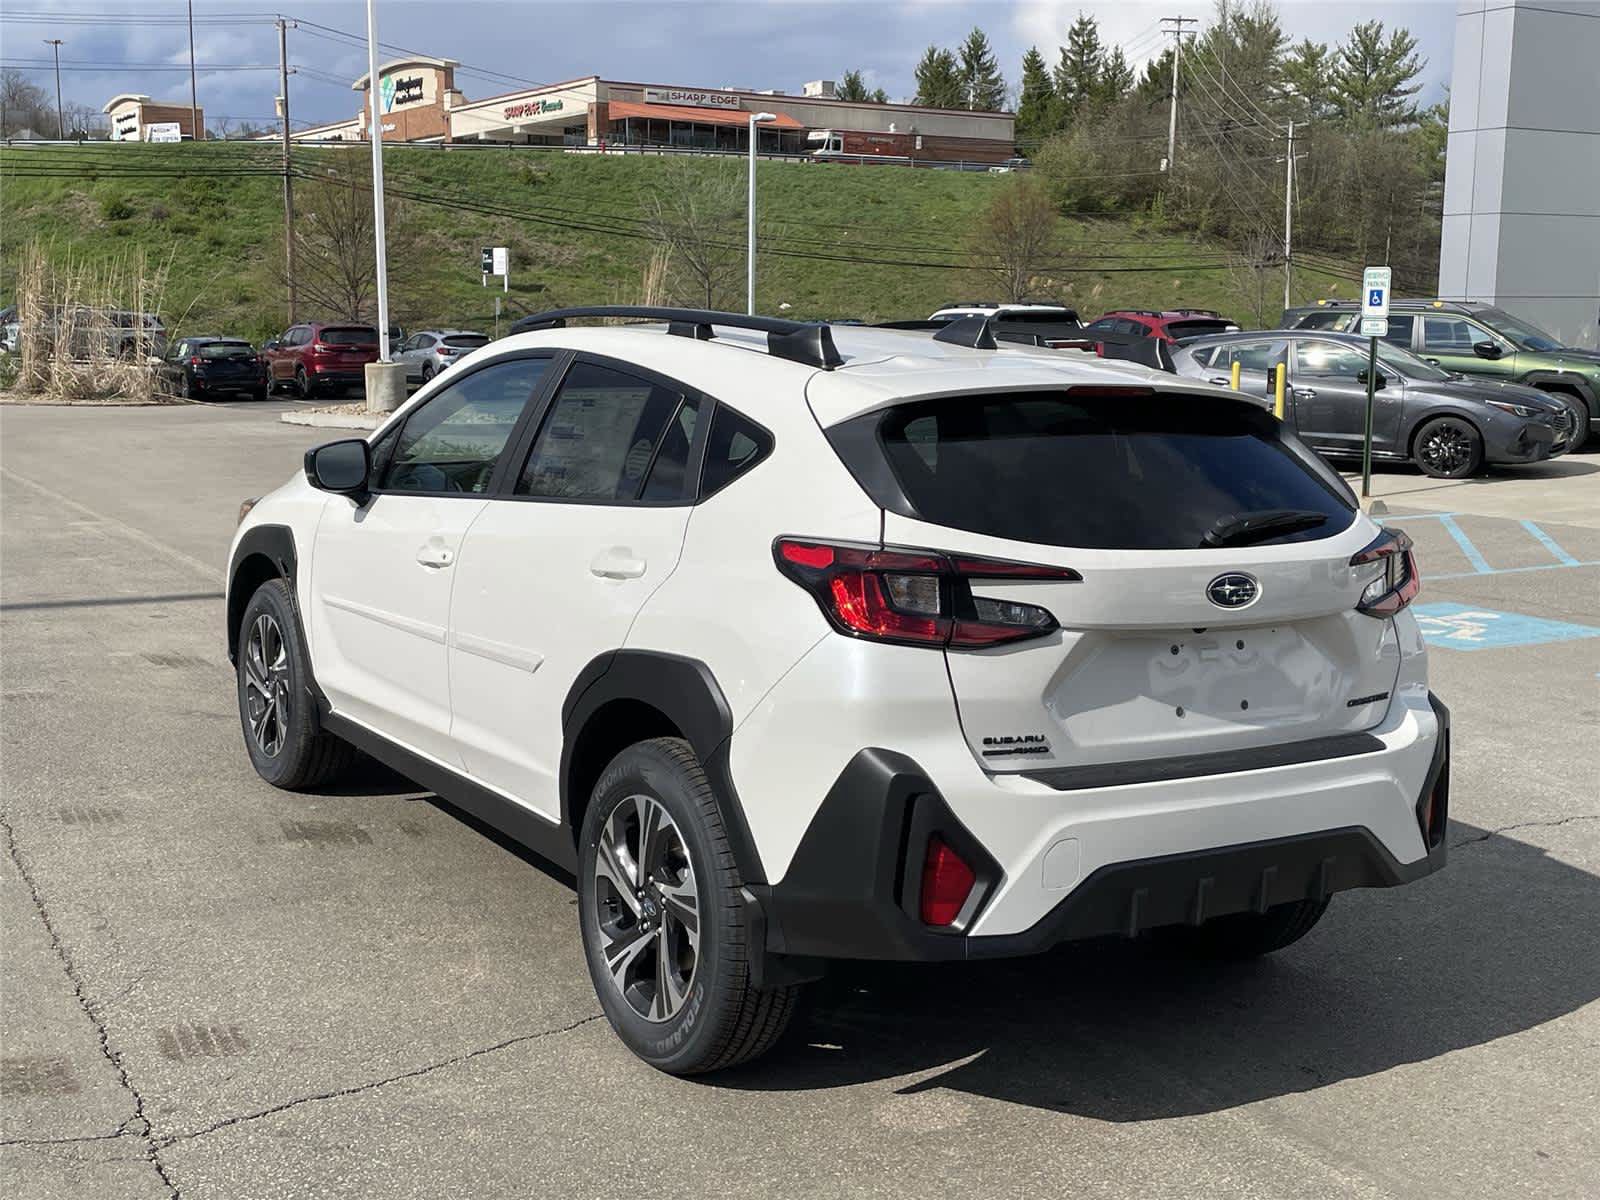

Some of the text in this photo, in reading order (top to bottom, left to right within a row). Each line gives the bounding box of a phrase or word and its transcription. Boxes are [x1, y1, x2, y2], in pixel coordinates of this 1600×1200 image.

[671, 91, 738, 105] SHARP EDGE
[982, 734, 1045, 745] SUBARU
